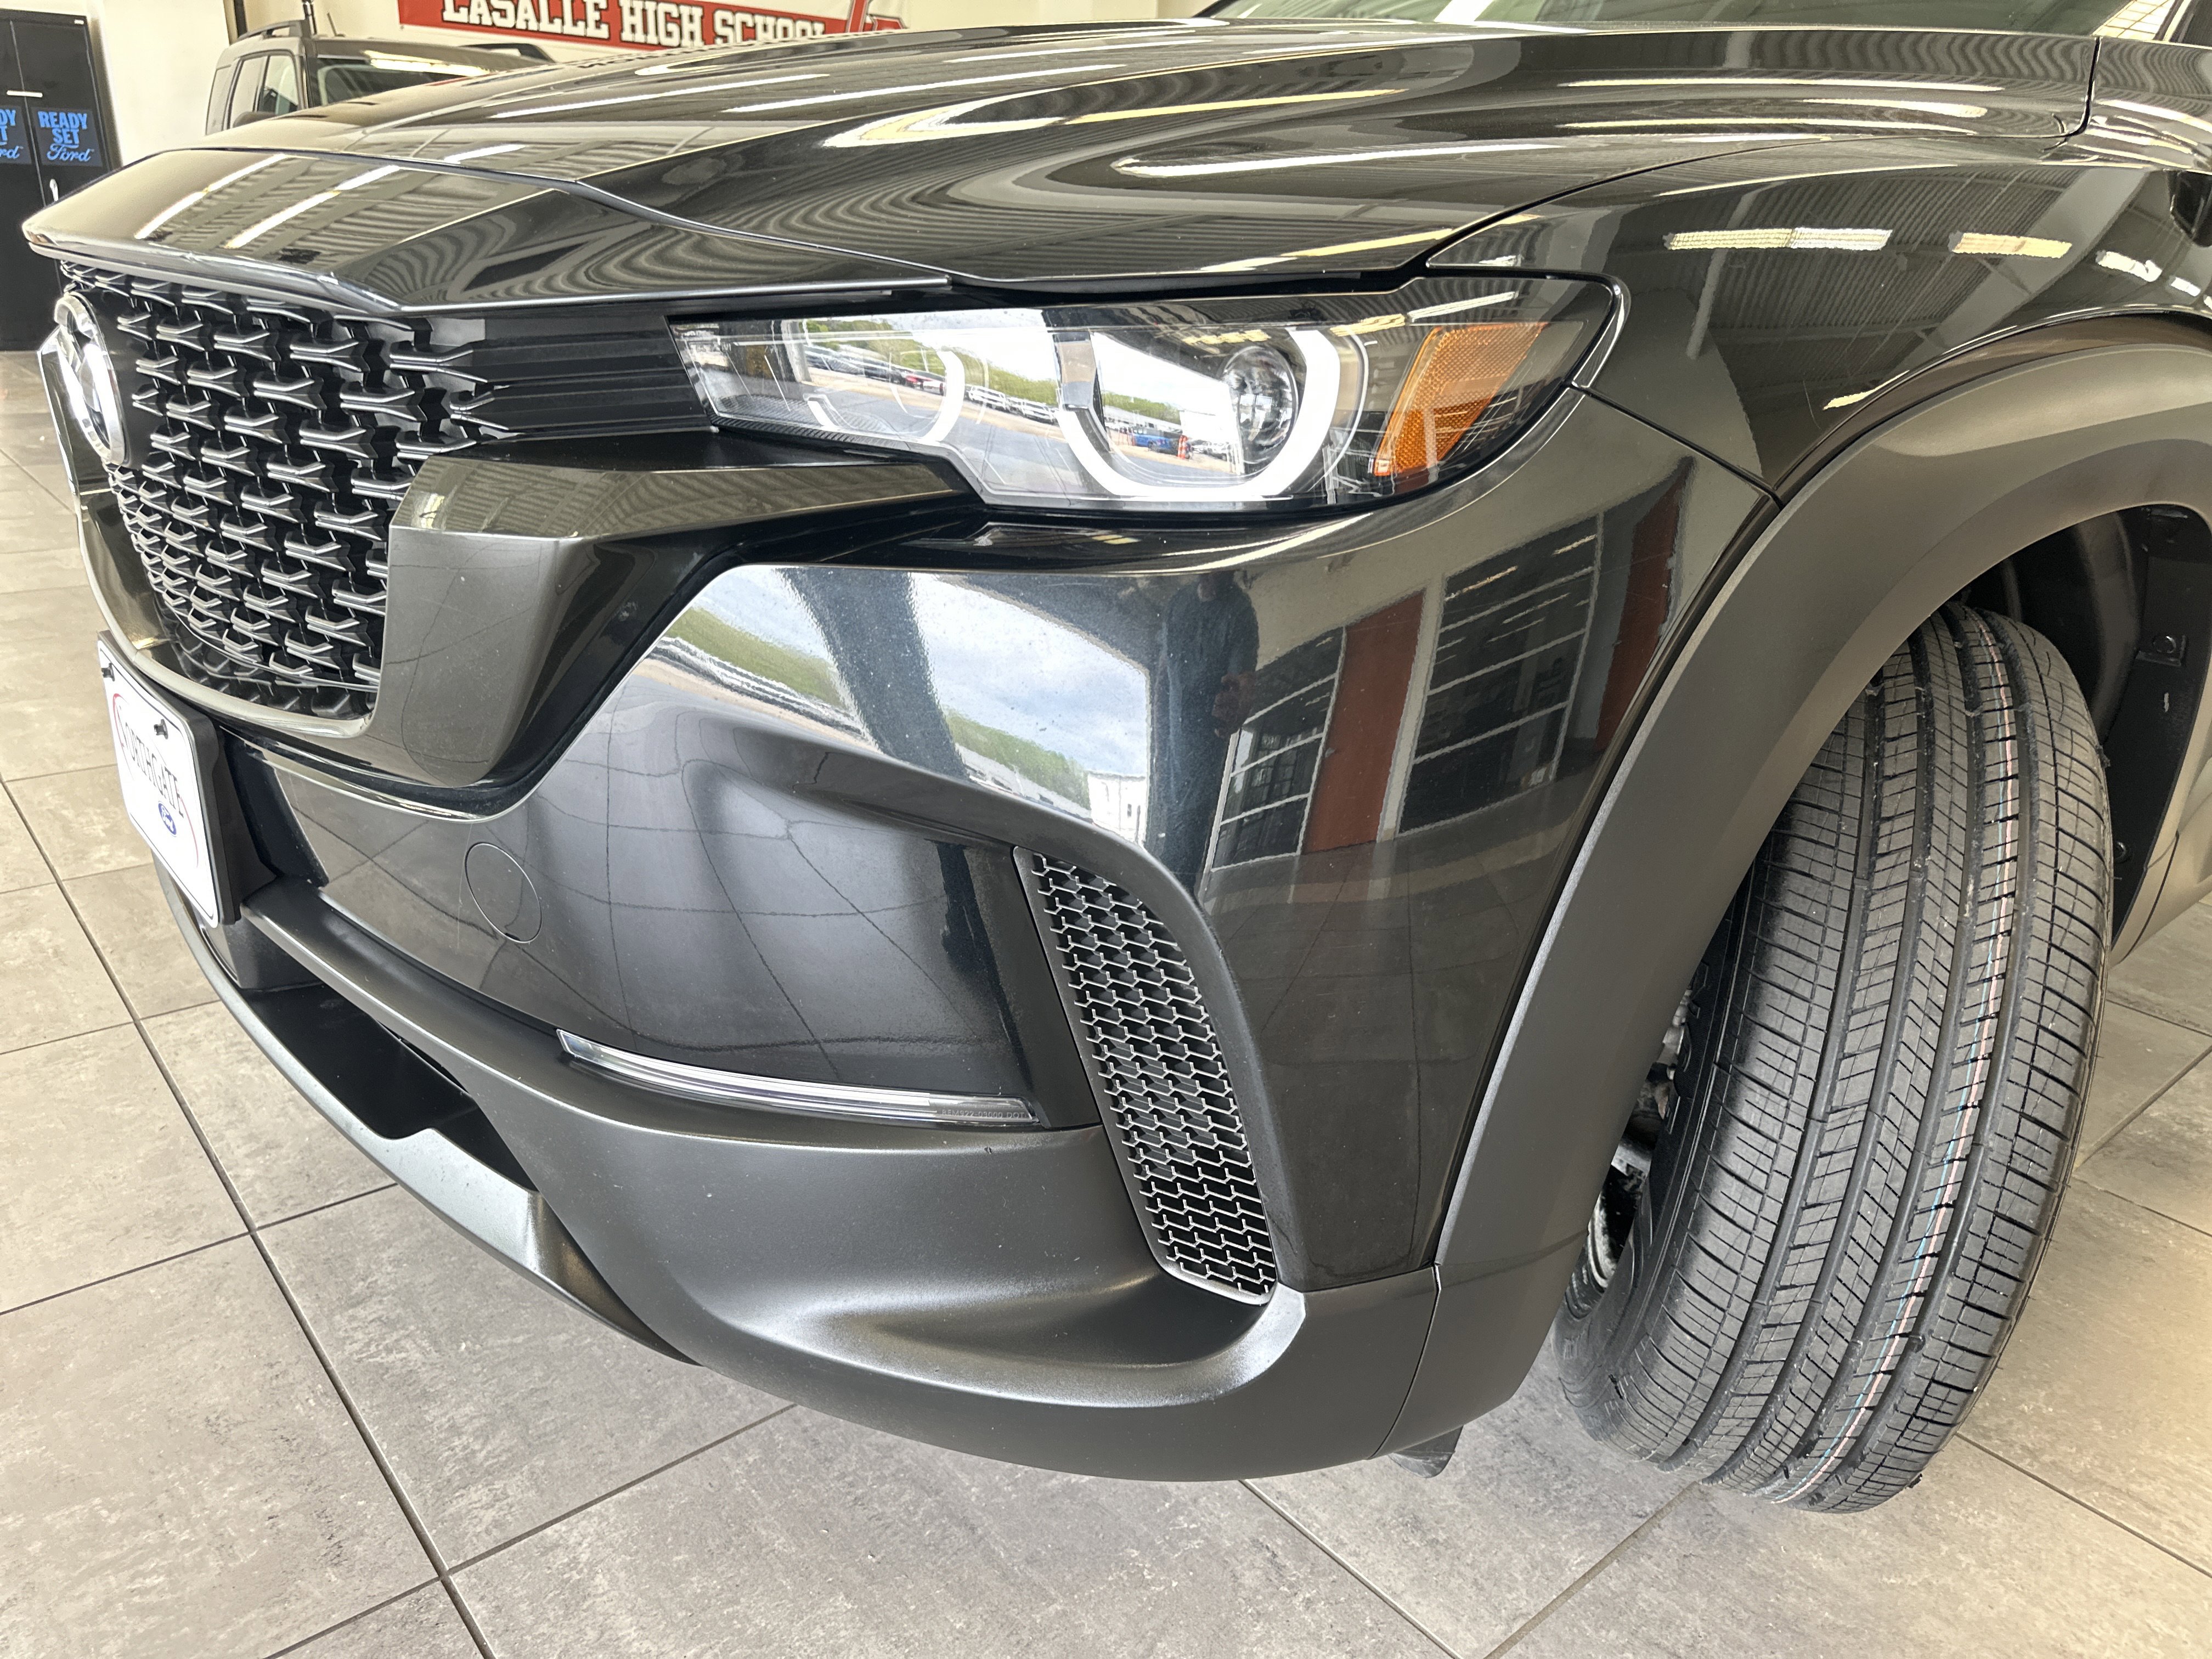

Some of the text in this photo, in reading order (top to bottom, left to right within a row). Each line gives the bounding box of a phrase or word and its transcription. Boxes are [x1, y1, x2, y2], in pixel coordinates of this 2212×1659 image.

[443, 0, 609, 39] LASALLE
[619, 0, 704, 47] HIGH
[38, 111, 87, 129] READY
[52, 128, 80, 144] SET
[0, 145, 20, 159] rd
[47, 143, 91, 162] Ford
